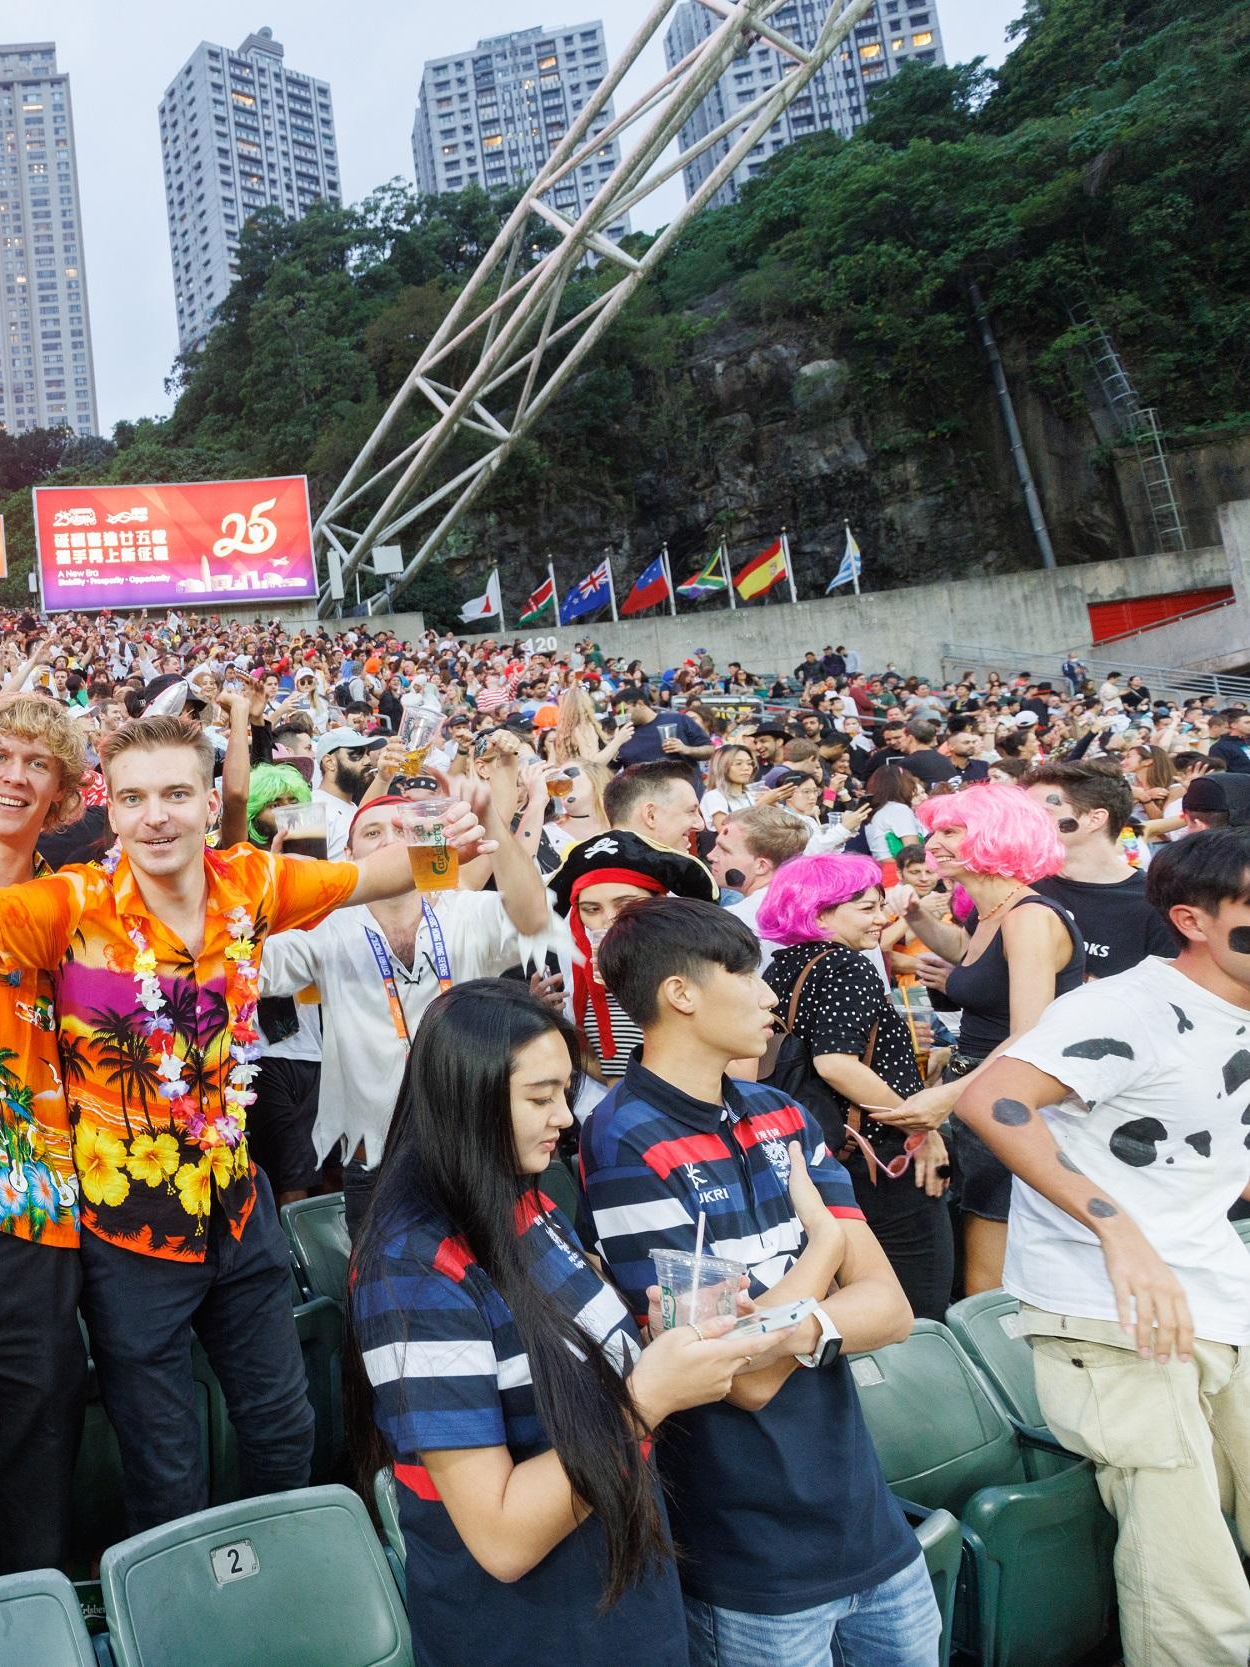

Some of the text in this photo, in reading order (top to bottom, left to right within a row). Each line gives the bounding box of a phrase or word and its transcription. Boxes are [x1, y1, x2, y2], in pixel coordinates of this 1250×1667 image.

[66, 569, 85, 577] New
[85, 568, 100, 577] Era
[227, 1548, 243, 1574] 2
